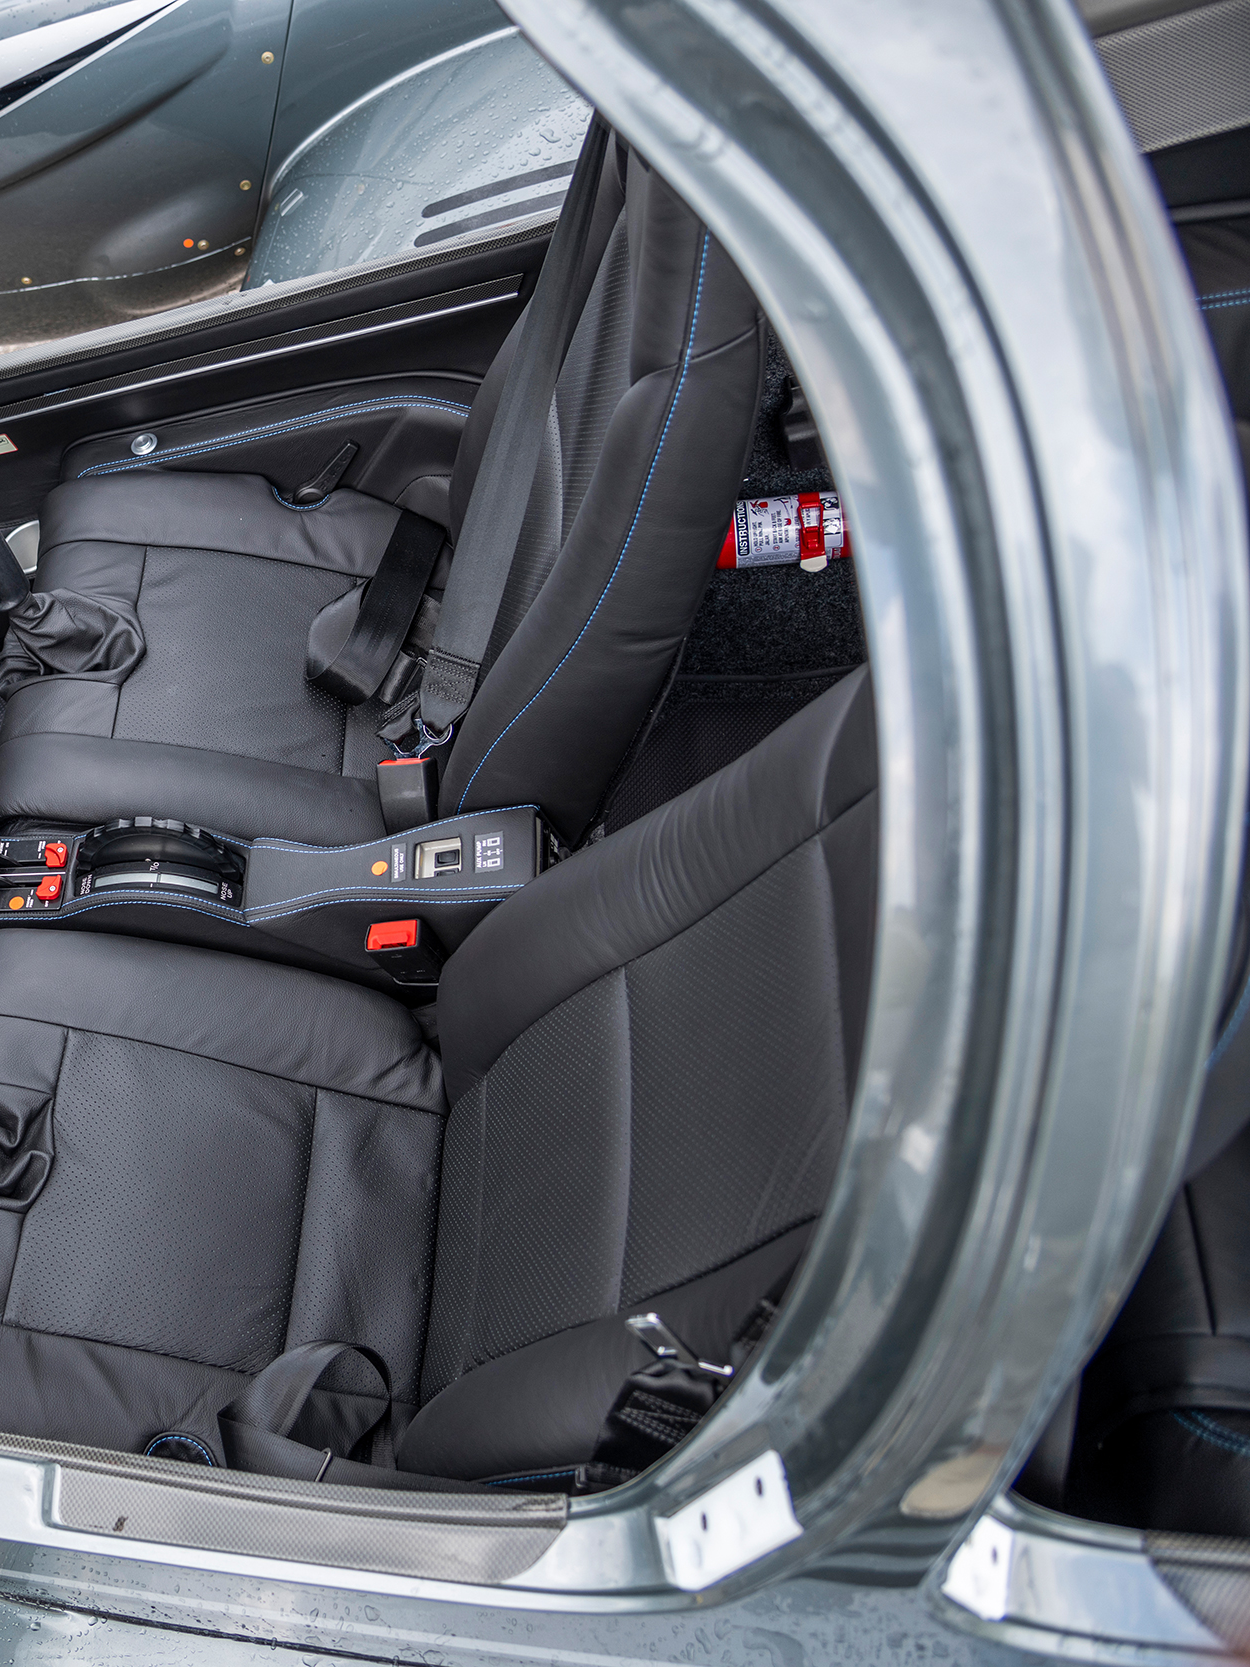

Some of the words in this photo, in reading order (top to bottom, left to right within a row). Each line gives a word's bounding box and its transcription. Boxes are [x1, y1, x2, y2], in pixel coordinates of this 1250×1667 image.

[737, 501, 749, 555] INSTRUCTIONS
[220, 882, 228, 901] NOSE
[227, 889, 233, 898] UP
